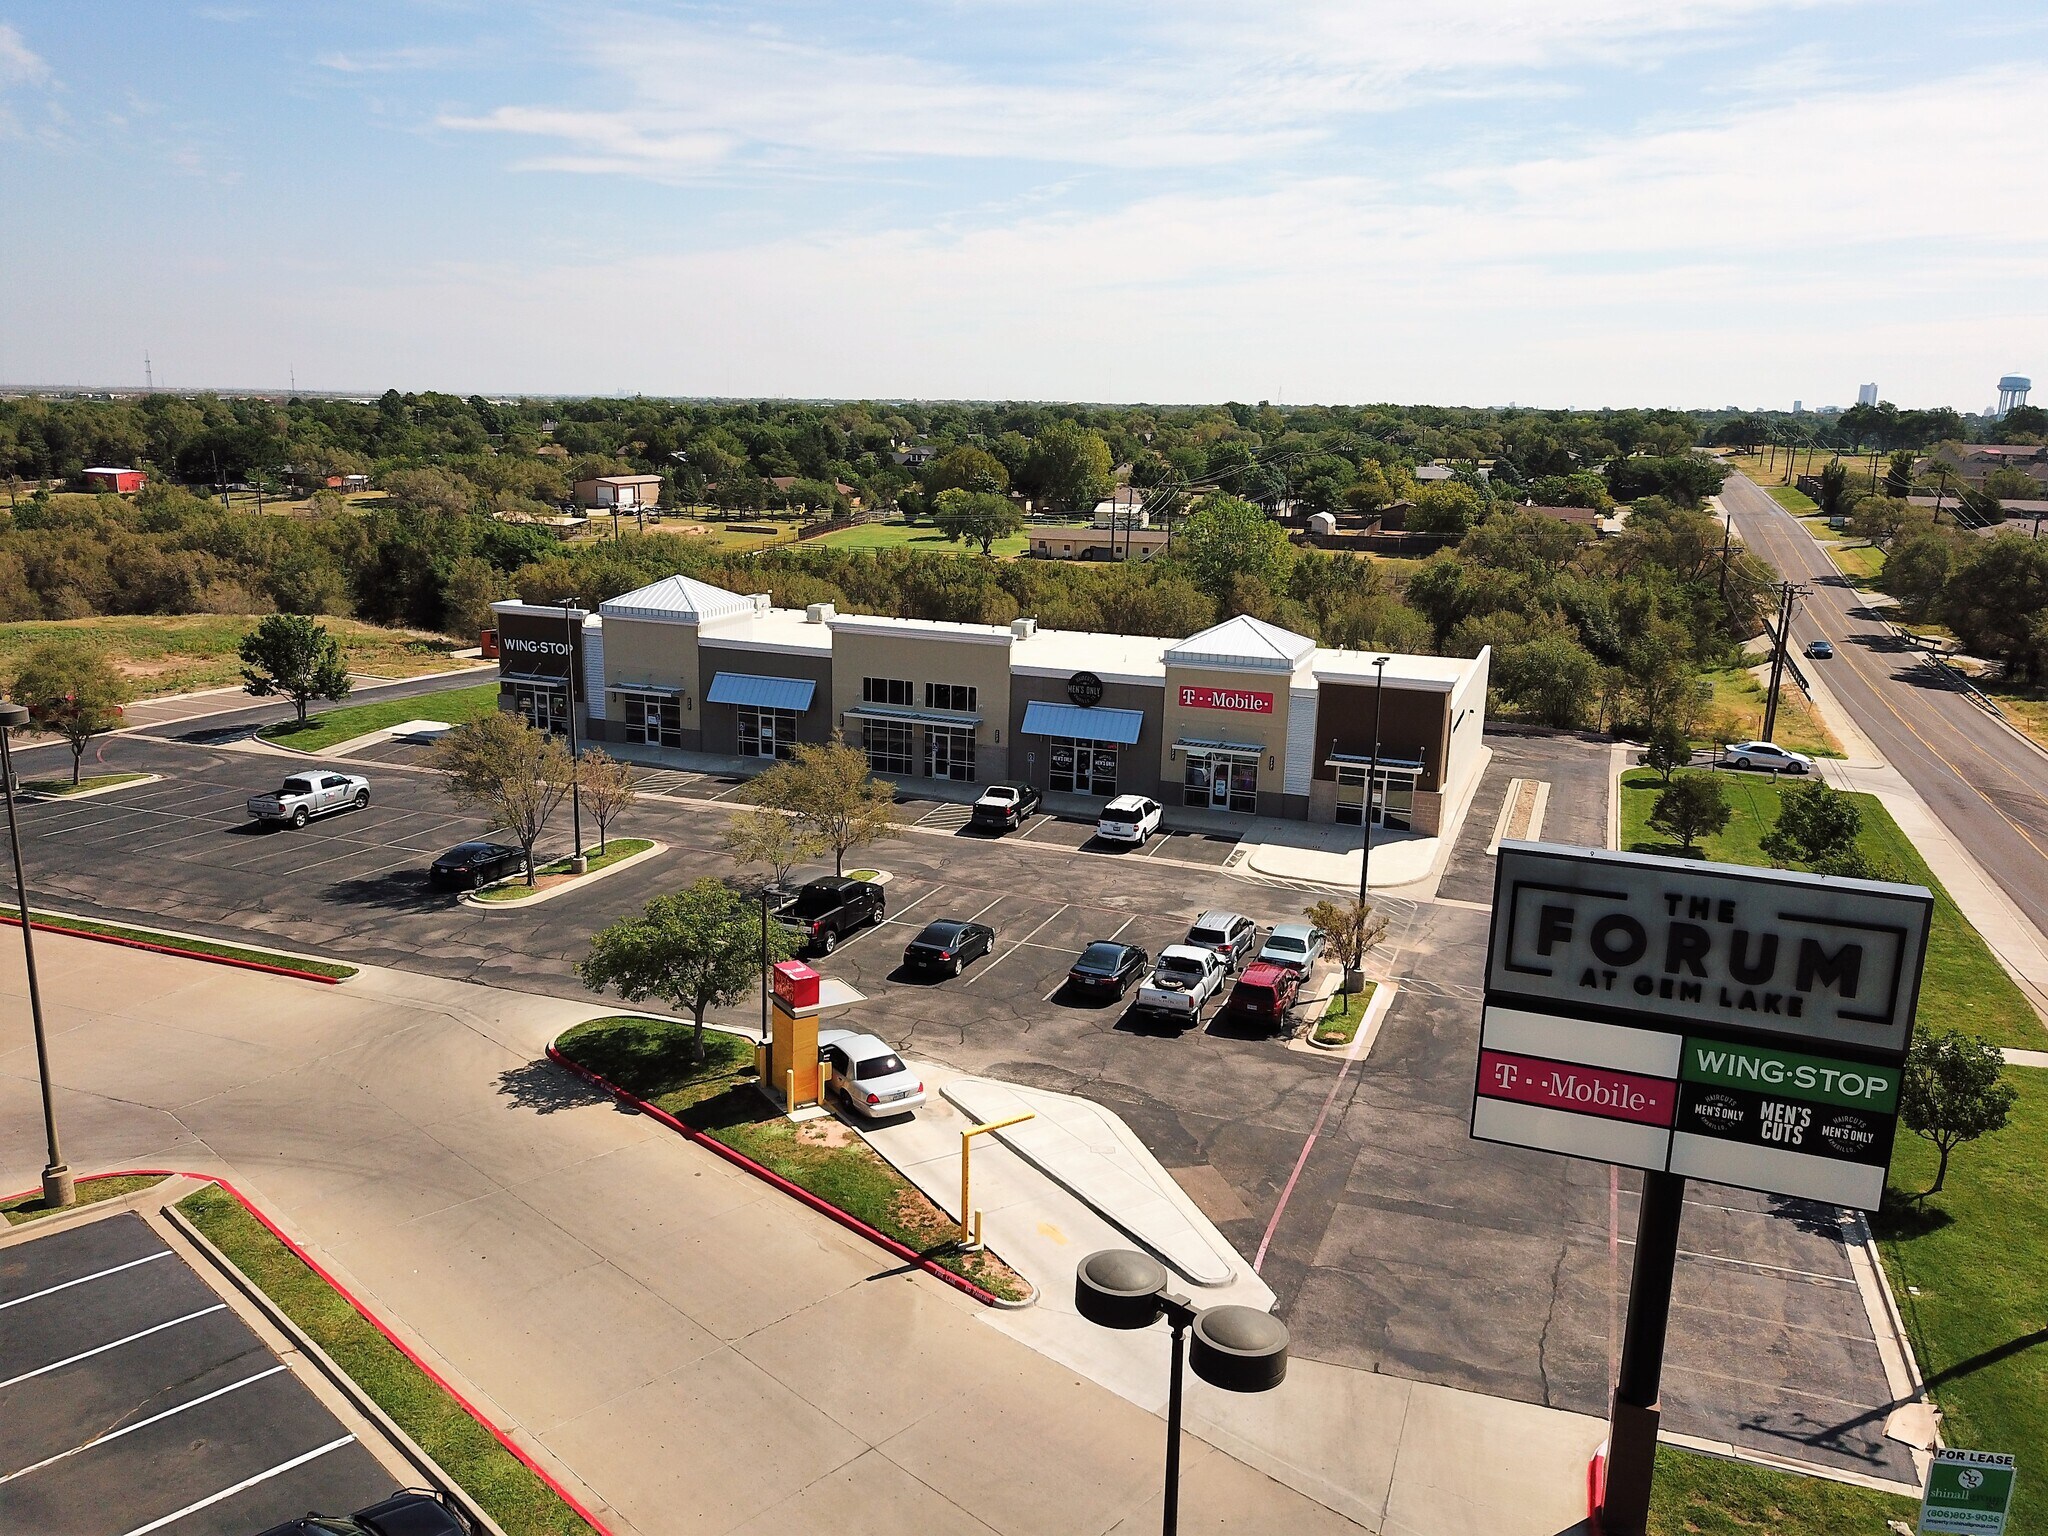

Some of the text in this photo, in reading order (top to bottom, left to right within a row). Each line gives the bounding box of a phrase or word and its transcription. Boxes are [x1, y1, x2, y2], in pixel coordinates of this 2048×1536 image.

[1664, 893, 1736, 924] THE
[1537, 904, 1863, 999] FORUM
[1579, 968, 1804, 1018] AT GEM LAKE
[1705, 1094, 1737, 1106] HAIRCUTS
[1694, 1103, 1744, 1121] MEN'S ONLY
[1760, 1100, 1812, 1128] MEN'S
[1832, 1115, 1867, 1128] HAIRCUTS
[1761, 1120, 1804, 1145] CUTS
[1822, 1125, 1874, 1143] MEN'S ONLY
[1938, 1450, 2013, 1466] FOR LEASE
[1930, 1488, 1970, 1500] shinall
